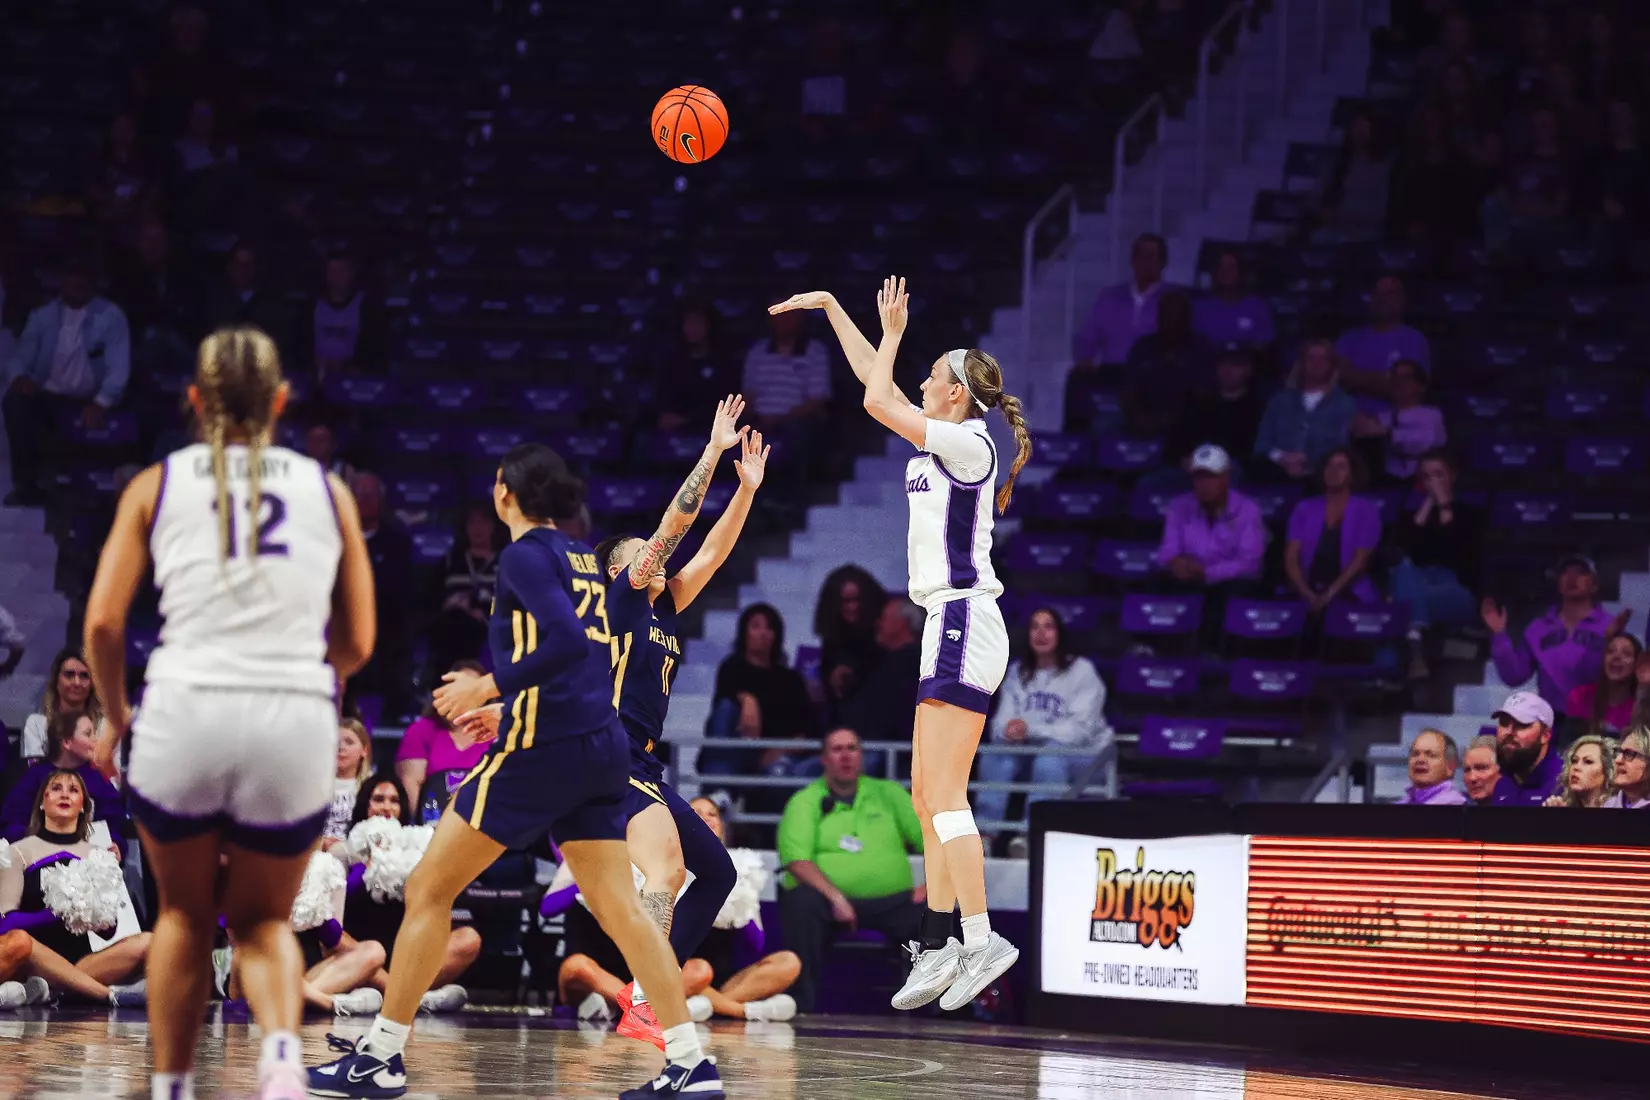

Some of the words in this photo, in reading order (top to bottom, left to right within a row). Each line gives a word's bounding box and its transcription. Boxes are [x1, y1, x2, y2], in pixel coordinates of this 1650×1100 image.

[212, 492, 289, 558] 12
[662, 655, 674, 696] 11
[1091, 846, 1196, 949] Briggs
